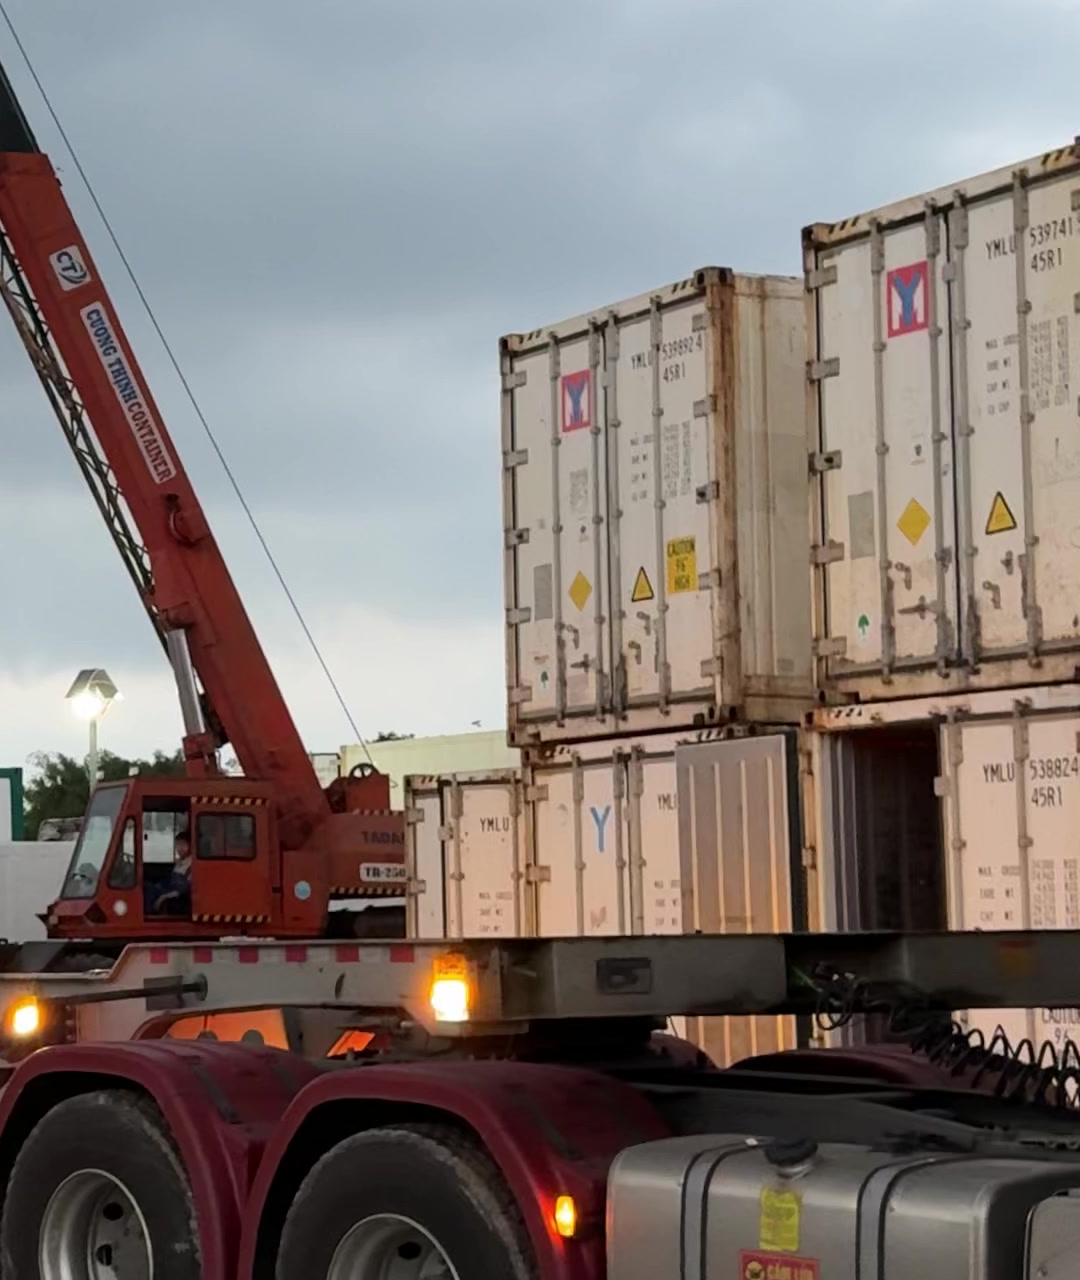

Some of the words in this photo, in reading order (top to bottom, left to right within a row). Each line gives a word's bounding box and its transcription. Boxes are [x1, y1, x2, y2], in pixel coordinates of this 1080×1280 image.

[985, 234, 1017, 260] YMLU
[127, 401, 170, 482] CONTAINER
[983, 763, 1015, 783] YMLU
[1031, 785, 1063, 807] 45R1
[480, 817, 509, 833] YMLU
[361, 831, 405, 846] TADA
